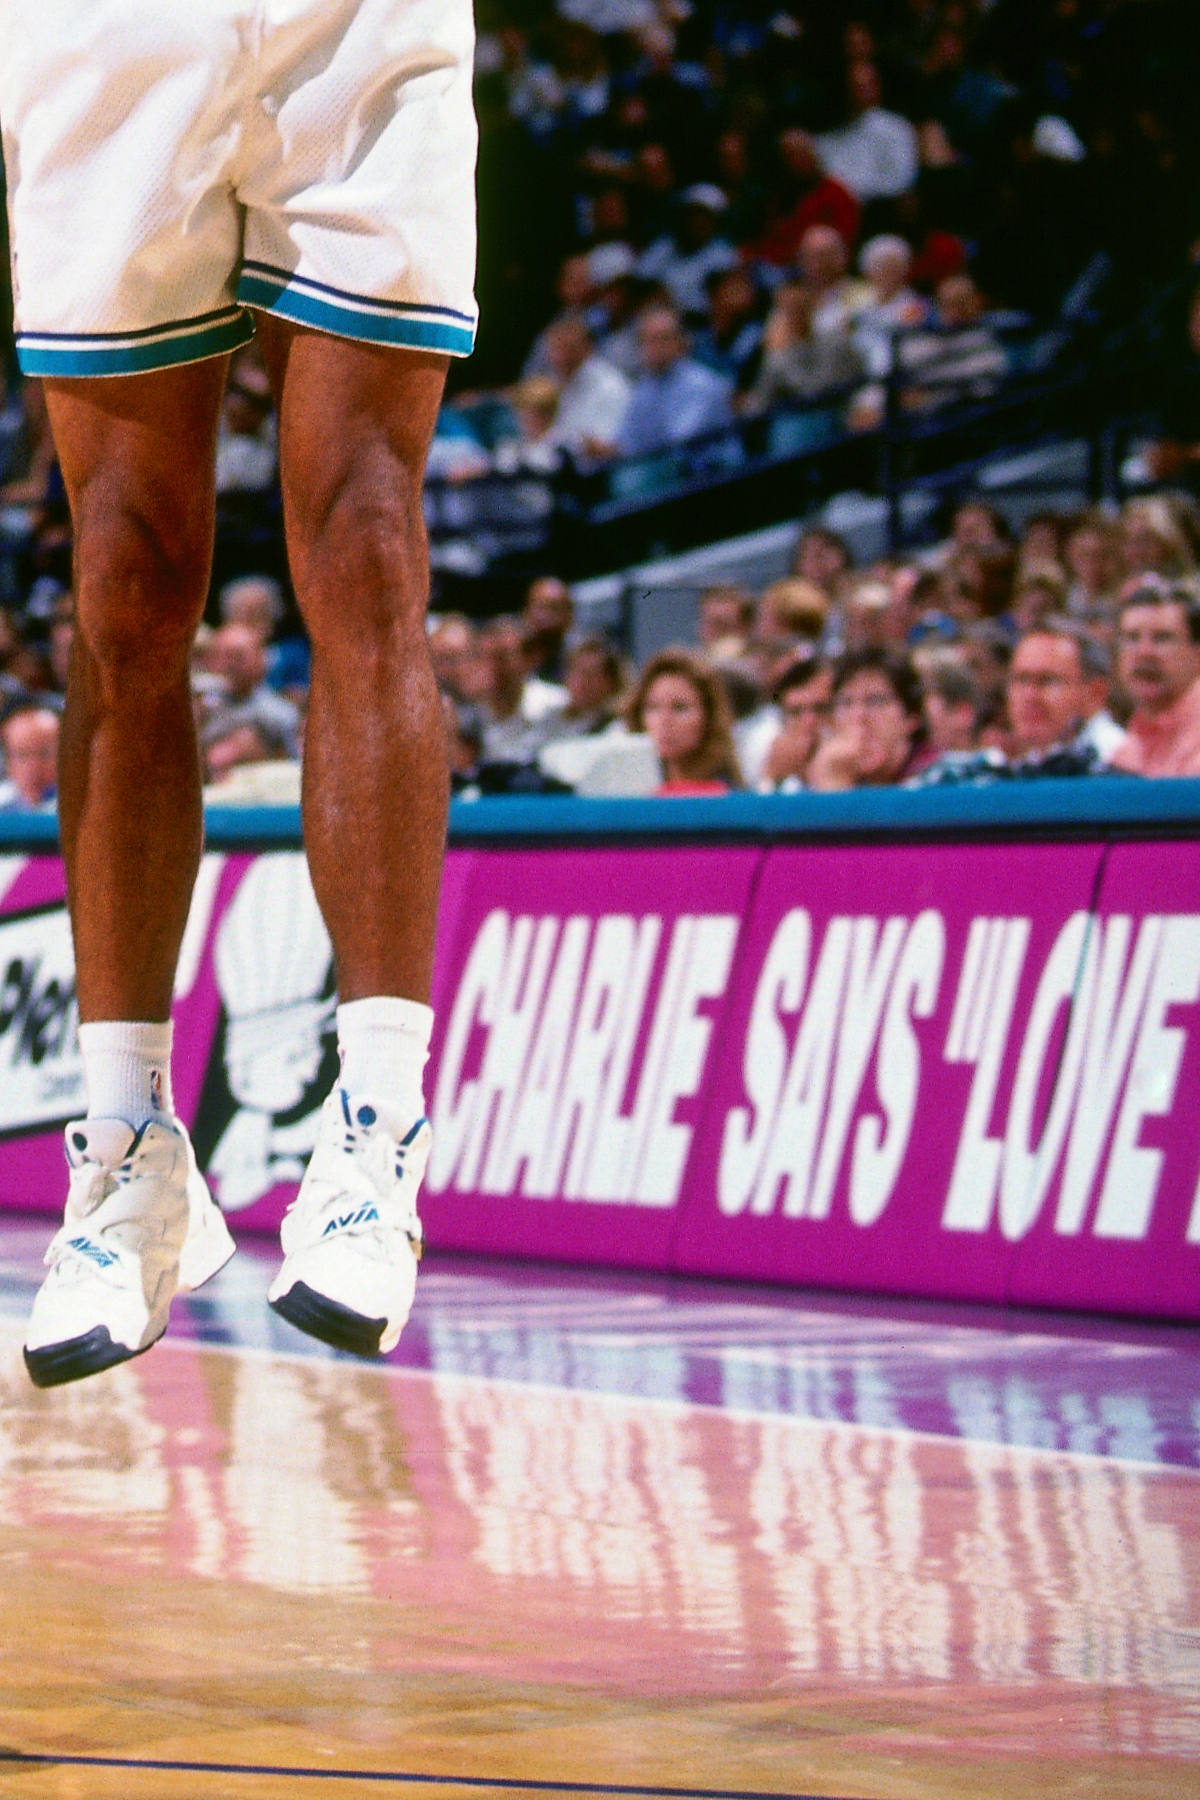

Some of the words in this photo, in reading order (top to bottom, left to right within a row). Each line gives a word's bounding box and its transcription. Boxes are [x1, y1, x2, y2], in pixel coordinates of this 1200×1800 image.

[426, 908, 740, 1207] CHARLIE
[717, 907, 946, 1227] SAYS
[322, 1201, 380, 1237] AVIA
